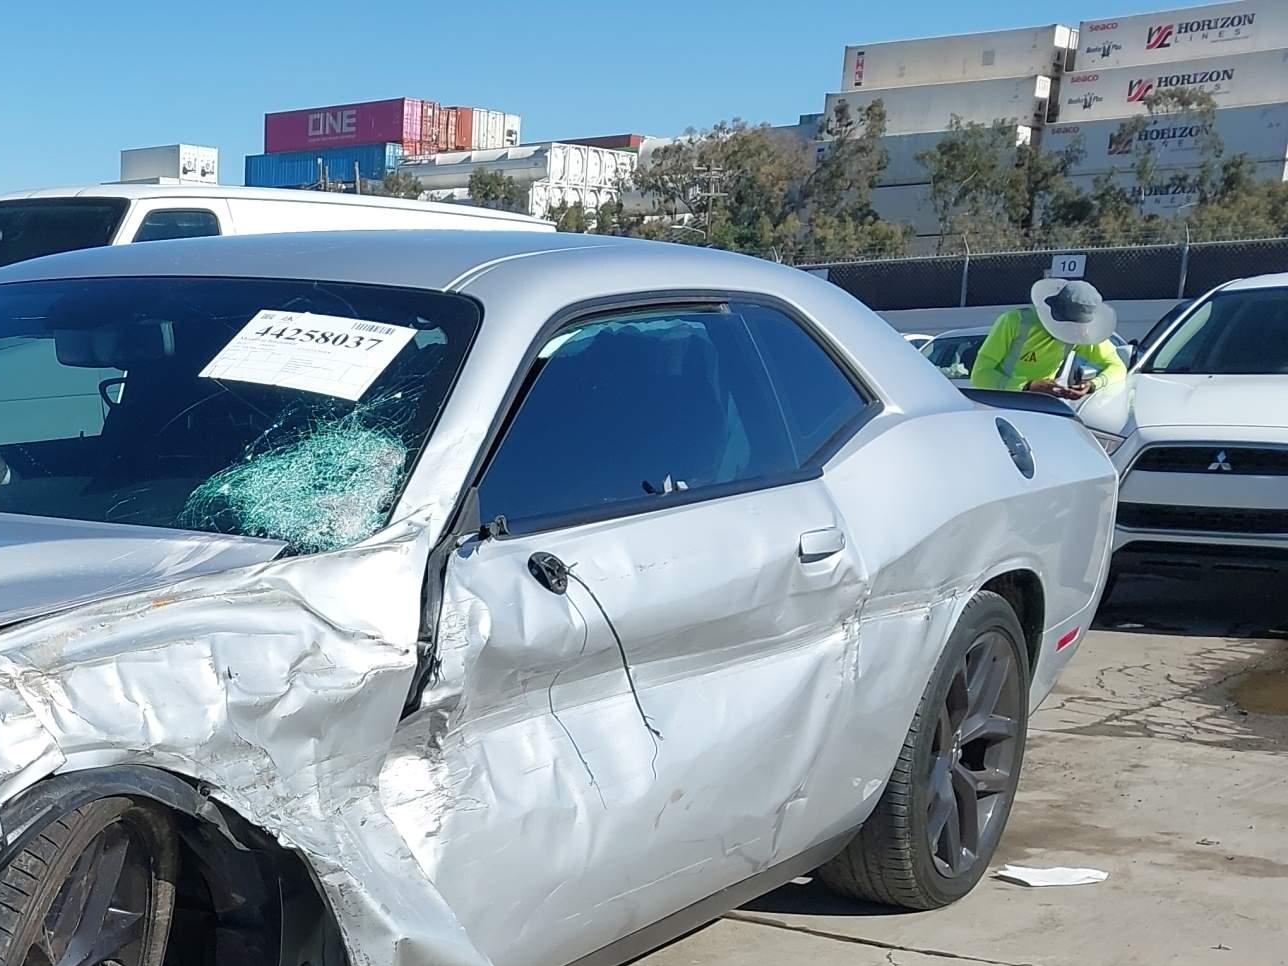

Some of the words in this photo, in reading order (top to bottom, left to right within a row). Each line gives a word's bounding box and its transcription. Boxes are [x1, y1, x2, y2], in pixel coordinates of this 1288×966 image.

[1089, 22, 1119, 32] seaco
[1177, 13, 1256, 34] HORIZON
[1174, 29, 1241, 43] LINES
[1070, 74, 1099, 83] seaco
[1156, 69, 1235, 88] HORIZON
[308, 110, 356, 136] ONE
[1051, 126, 1080, 135] seaco
[1061, 261, 1077, 272] 10
[255, 325, 384, 351] 44258037
